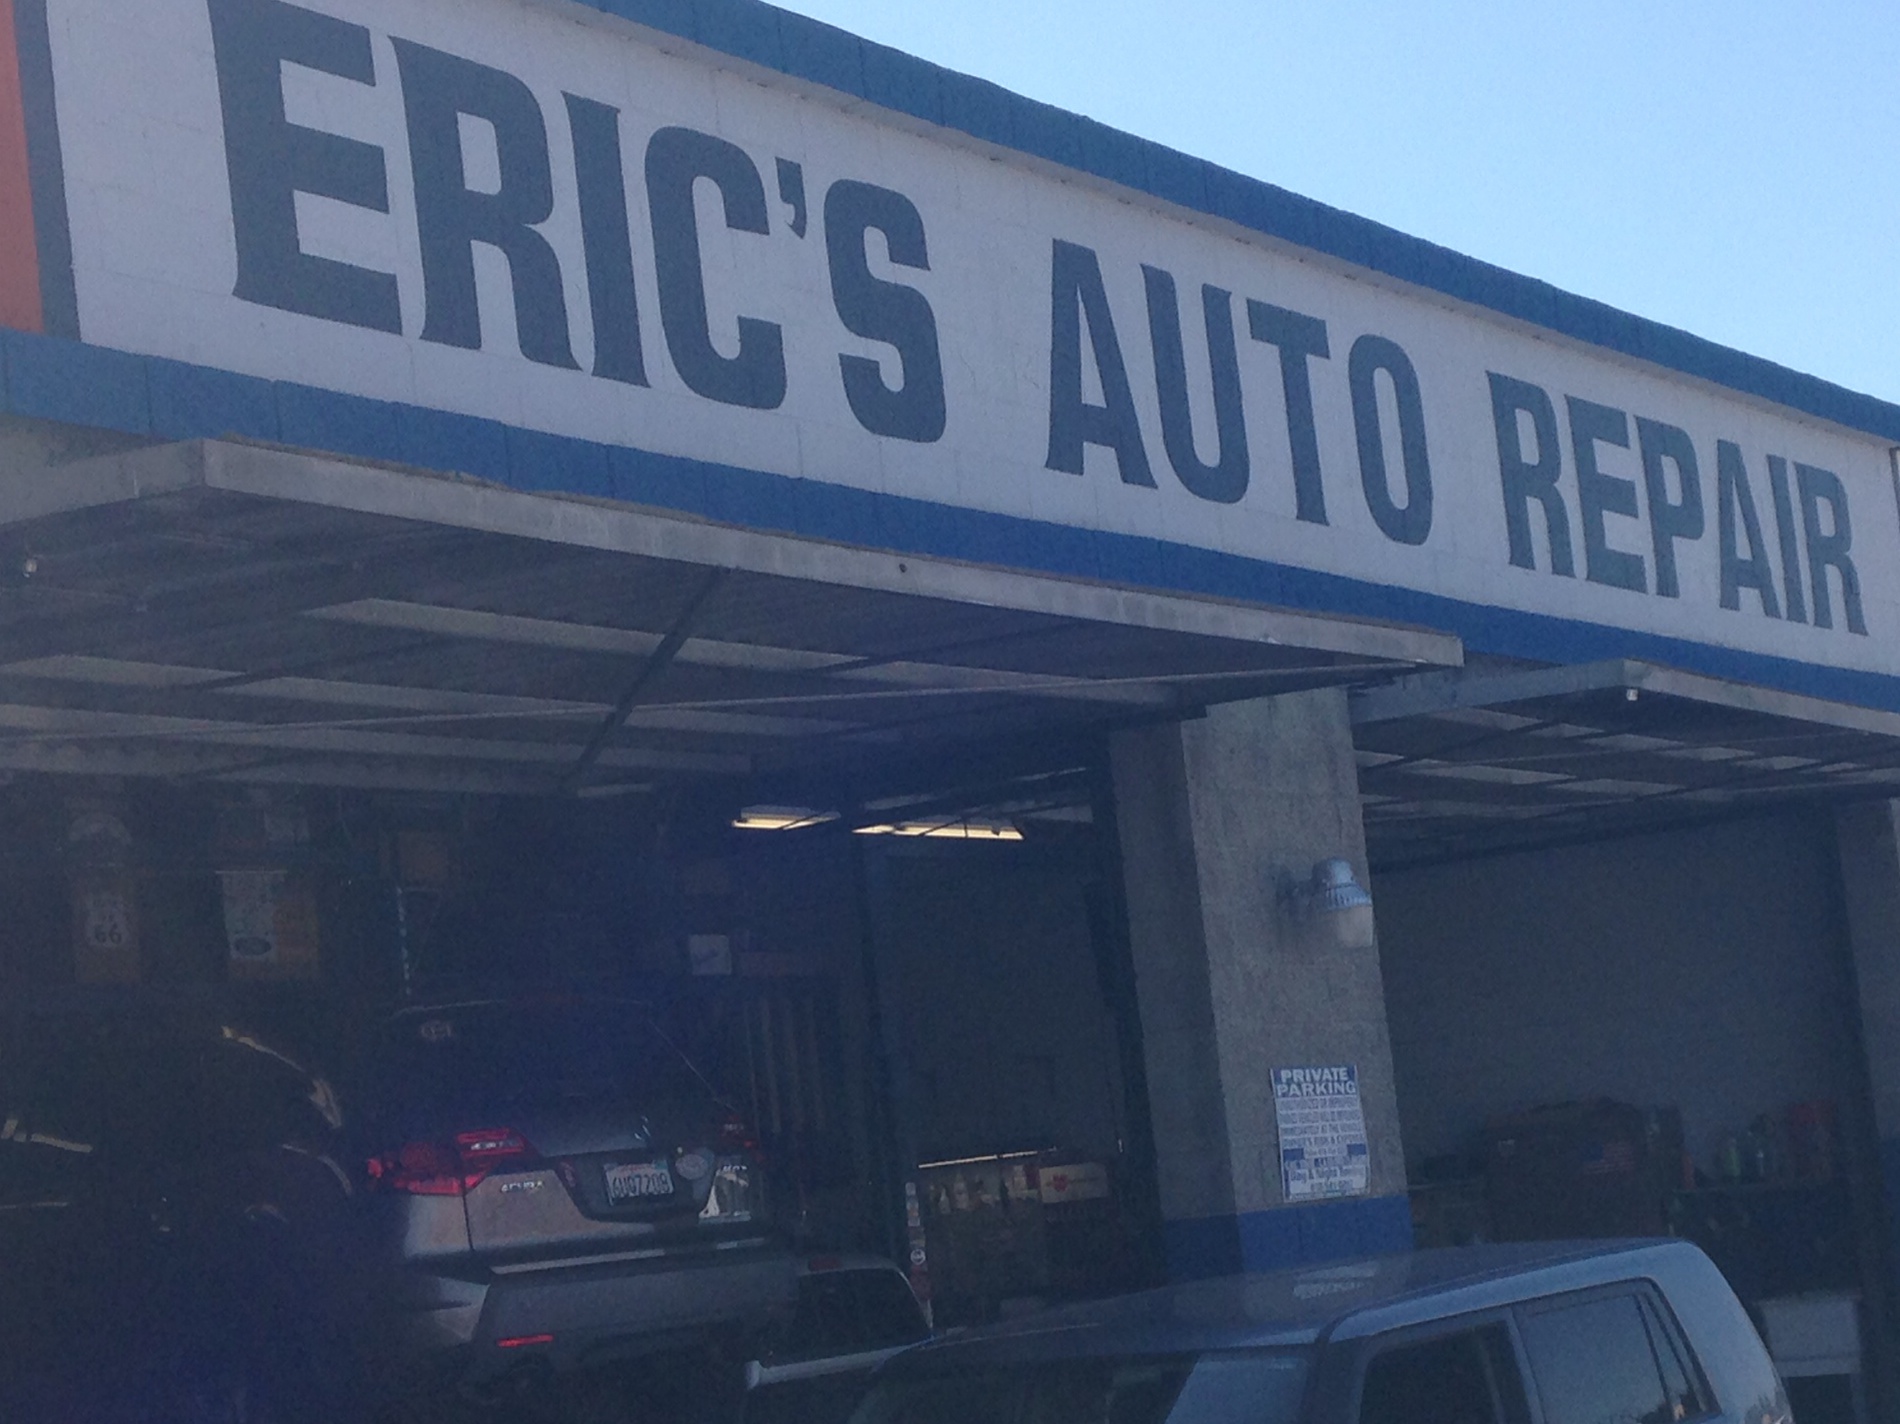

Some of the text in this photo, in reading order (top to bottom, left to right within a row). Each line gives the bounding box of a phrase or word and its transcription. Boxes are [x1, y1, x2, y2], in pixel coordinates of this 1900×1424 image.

[208, 0, 1868, 635] ERIC'S AUTO REPAIR
[1281, 1067, 1348, 1082] PRIVATE
[1277, 1081, 1356, 1096] PARKING
[501, 1181, 544, 1193] ACURA
